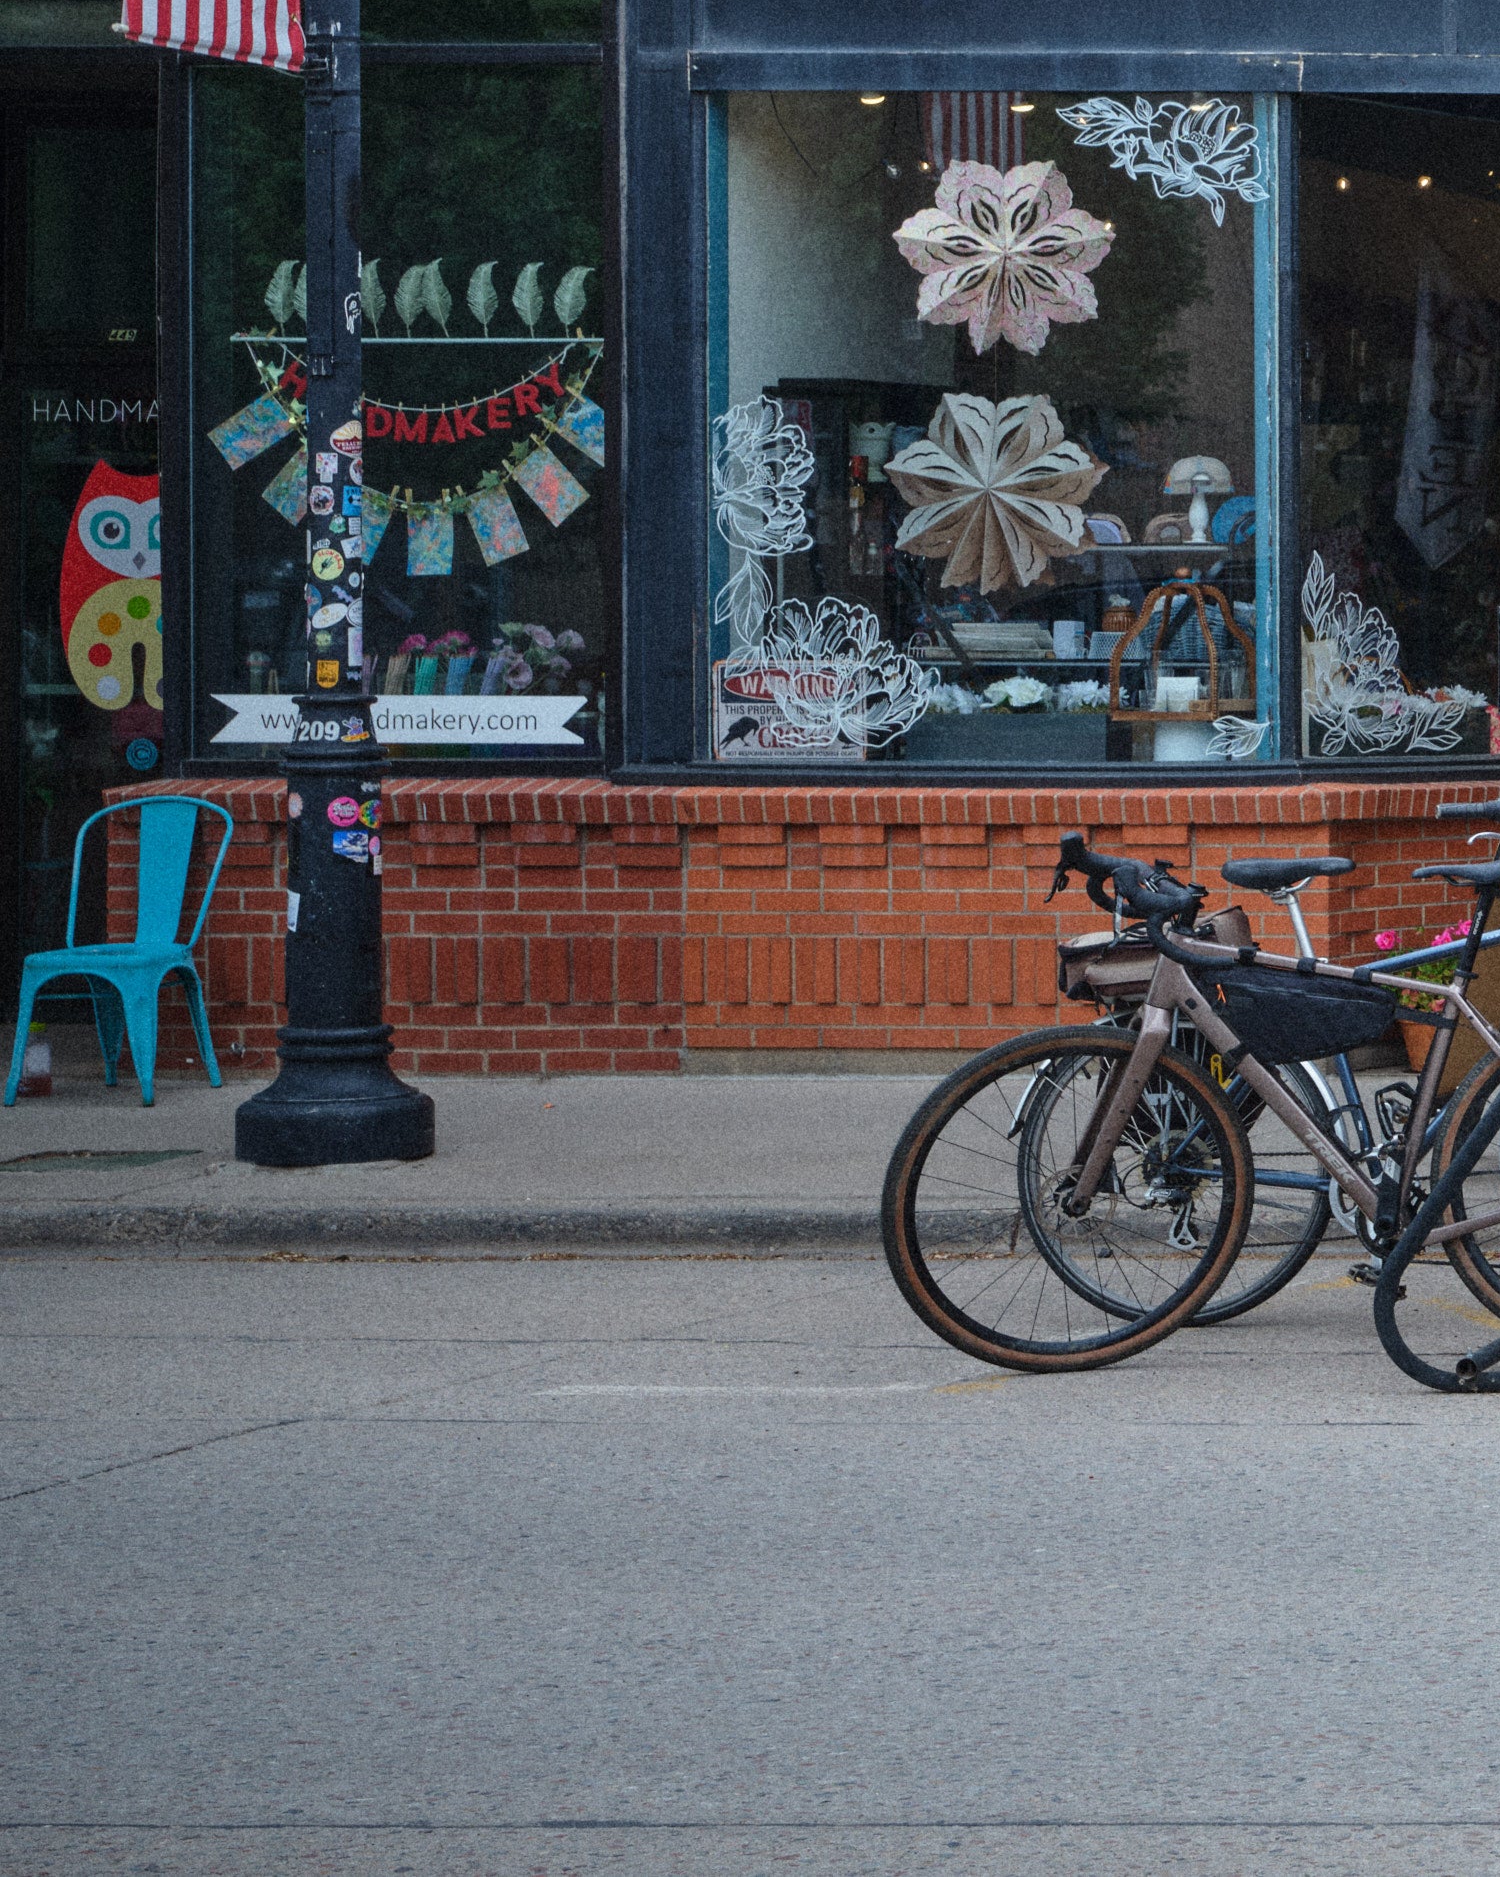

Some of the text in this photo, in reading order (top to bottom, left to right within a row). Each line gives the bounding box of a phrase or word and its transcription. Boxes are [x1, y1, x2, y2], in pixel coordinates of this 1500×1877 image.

[280, 362, 564, 444] HDMAKERY
[725, 705, 745, 715] THIS
[297, 721, 342, 742] 209
[1304, 1127, 1356, 1184] TREK
